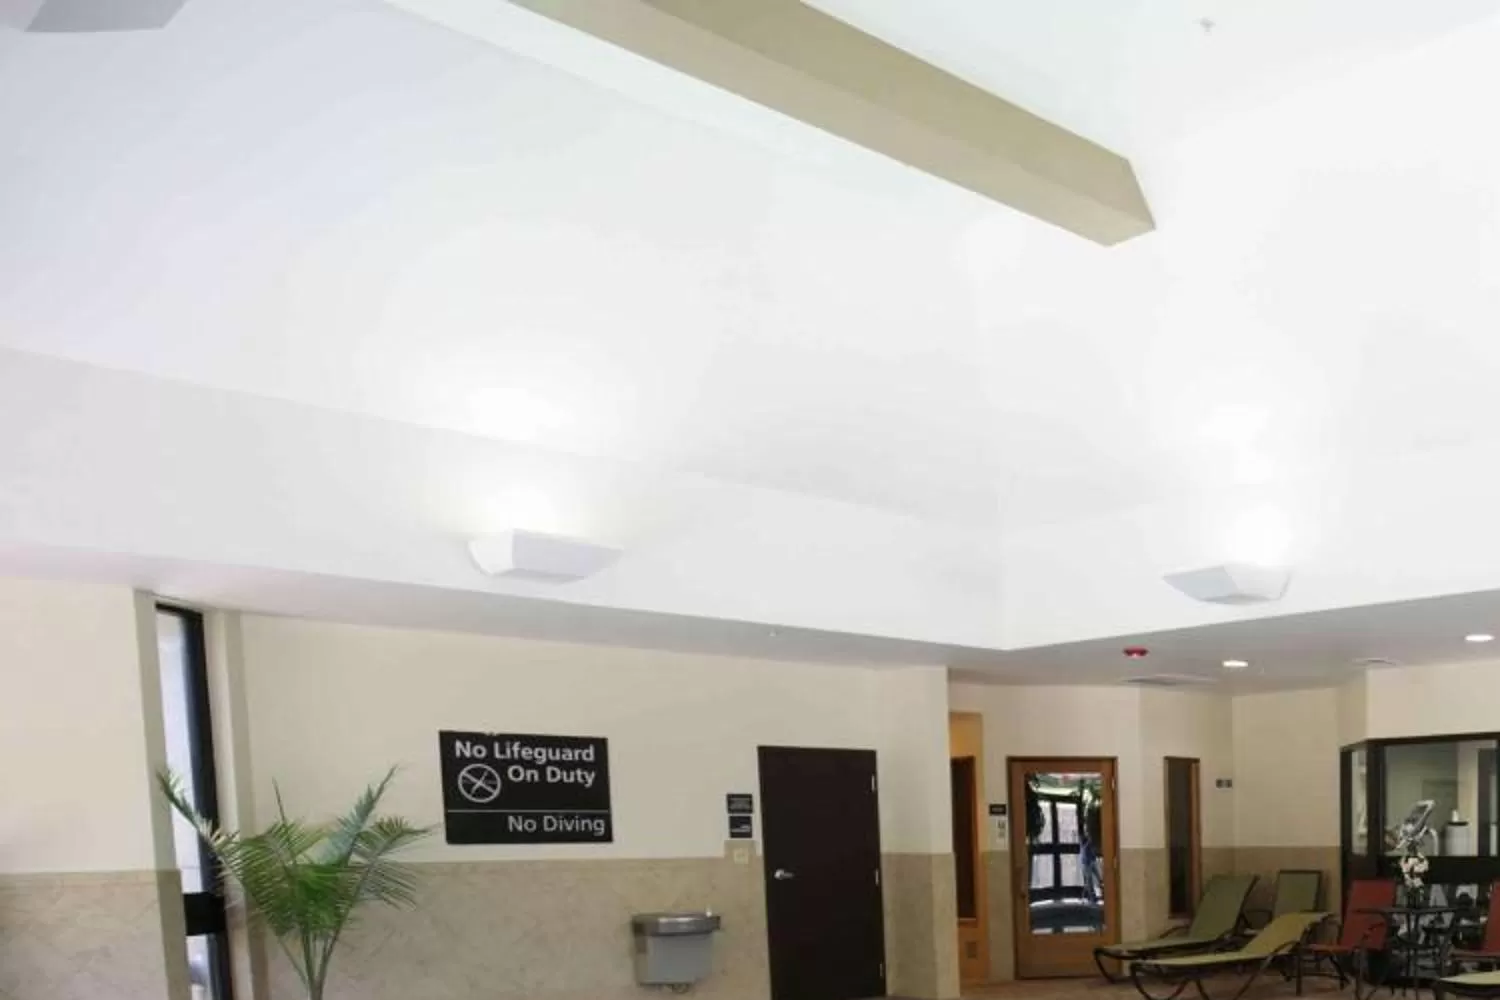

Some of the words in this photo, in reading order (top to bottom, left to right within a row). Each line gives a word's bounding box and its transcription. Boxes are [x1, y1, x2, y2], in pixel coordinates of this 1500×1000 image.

[455, 739, 487, 758] No
[493, 741, 595, 765] Lifeguard
[507, 765, 539, 782] On
[545, 766, 595, 788] Duty
[507, 815, 537, 832] No
[543, 815, 605, 836] Diving
